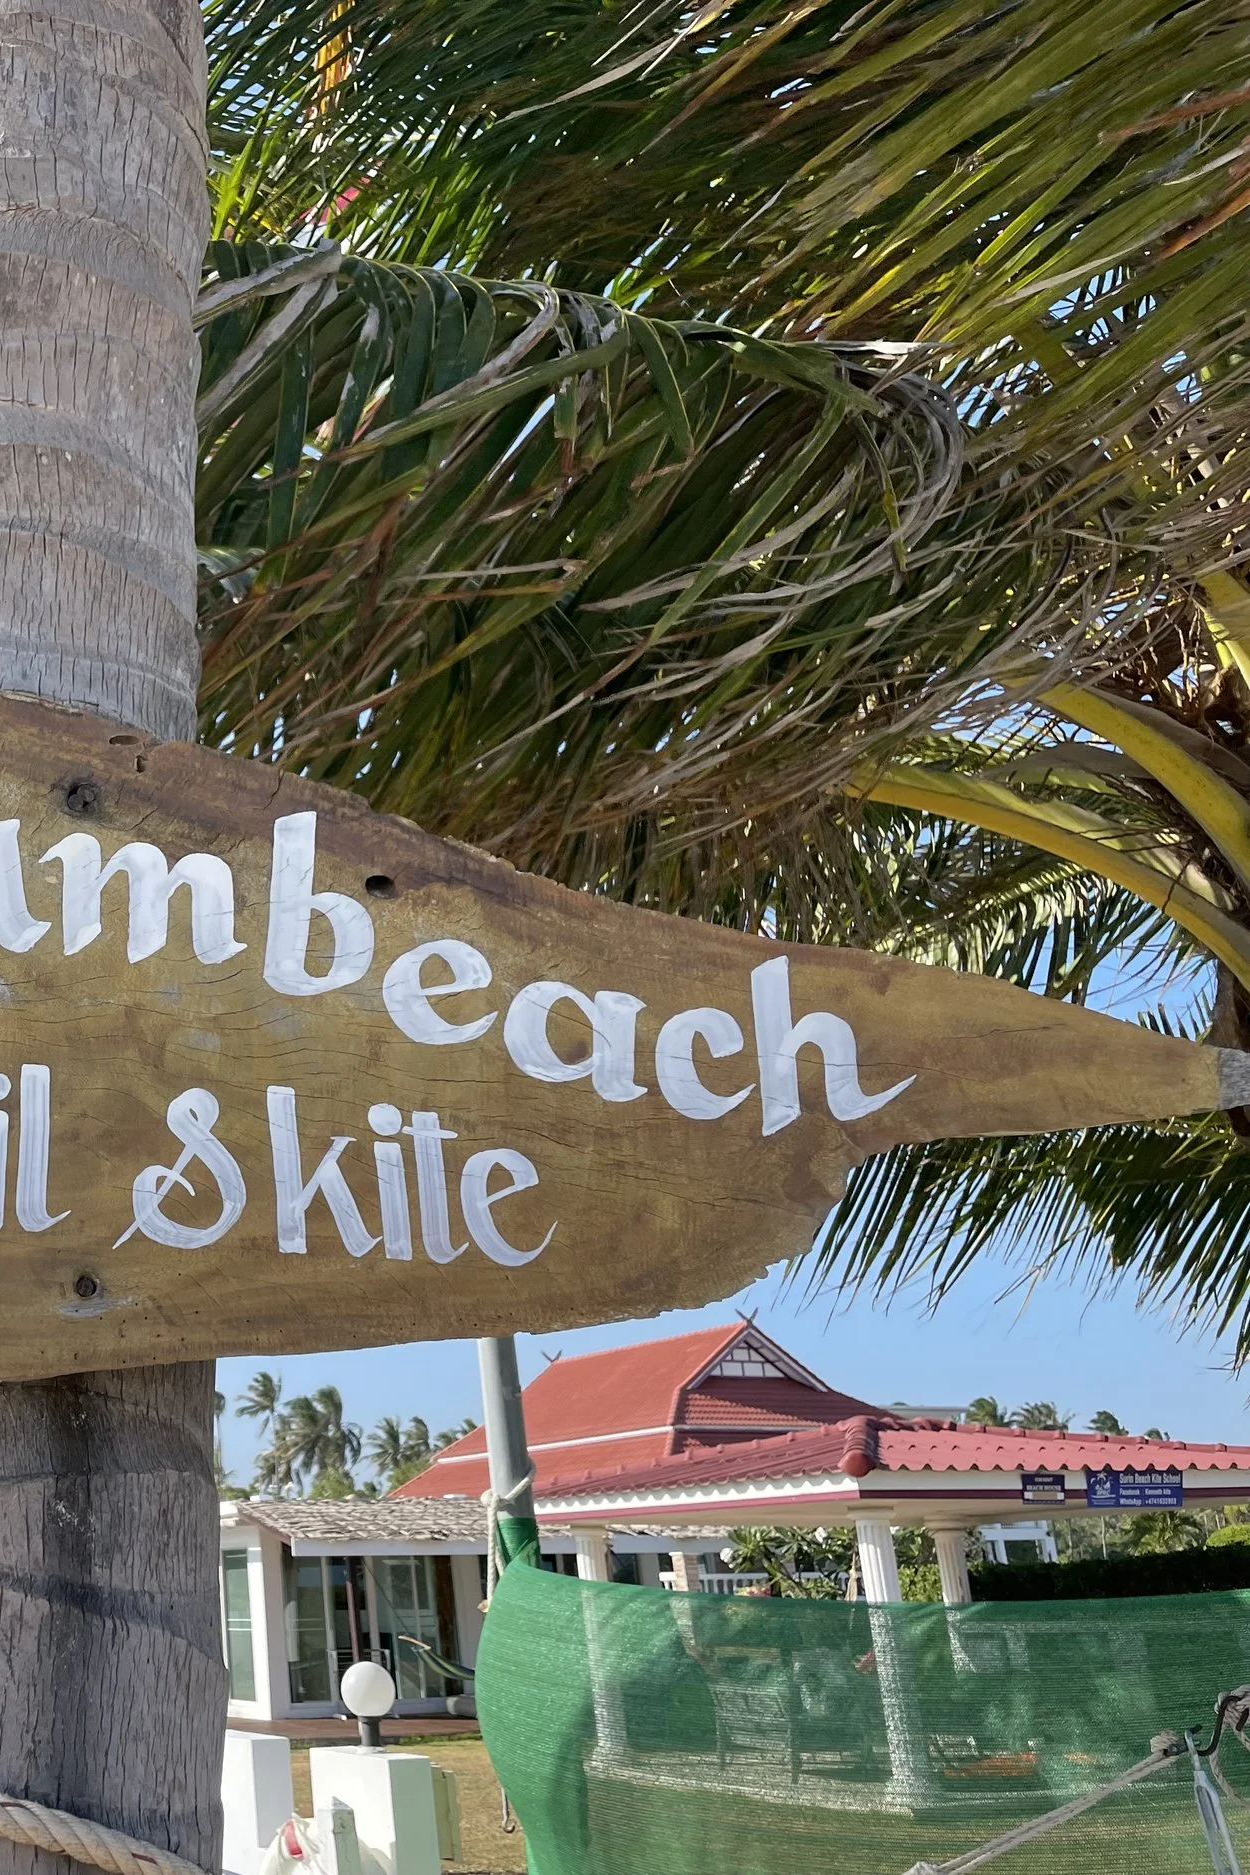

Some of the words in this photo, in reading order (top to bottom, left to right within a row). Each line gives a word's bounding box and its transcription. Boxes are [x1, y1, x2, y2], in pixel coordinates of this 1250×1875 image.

[267, 1085, 558, 1268] kite
[1134, 1473, 1151, 1483] Beach
[1151, 1473, 1162, 1483] Kite
[1162, 1473, 1181, 1483] School
